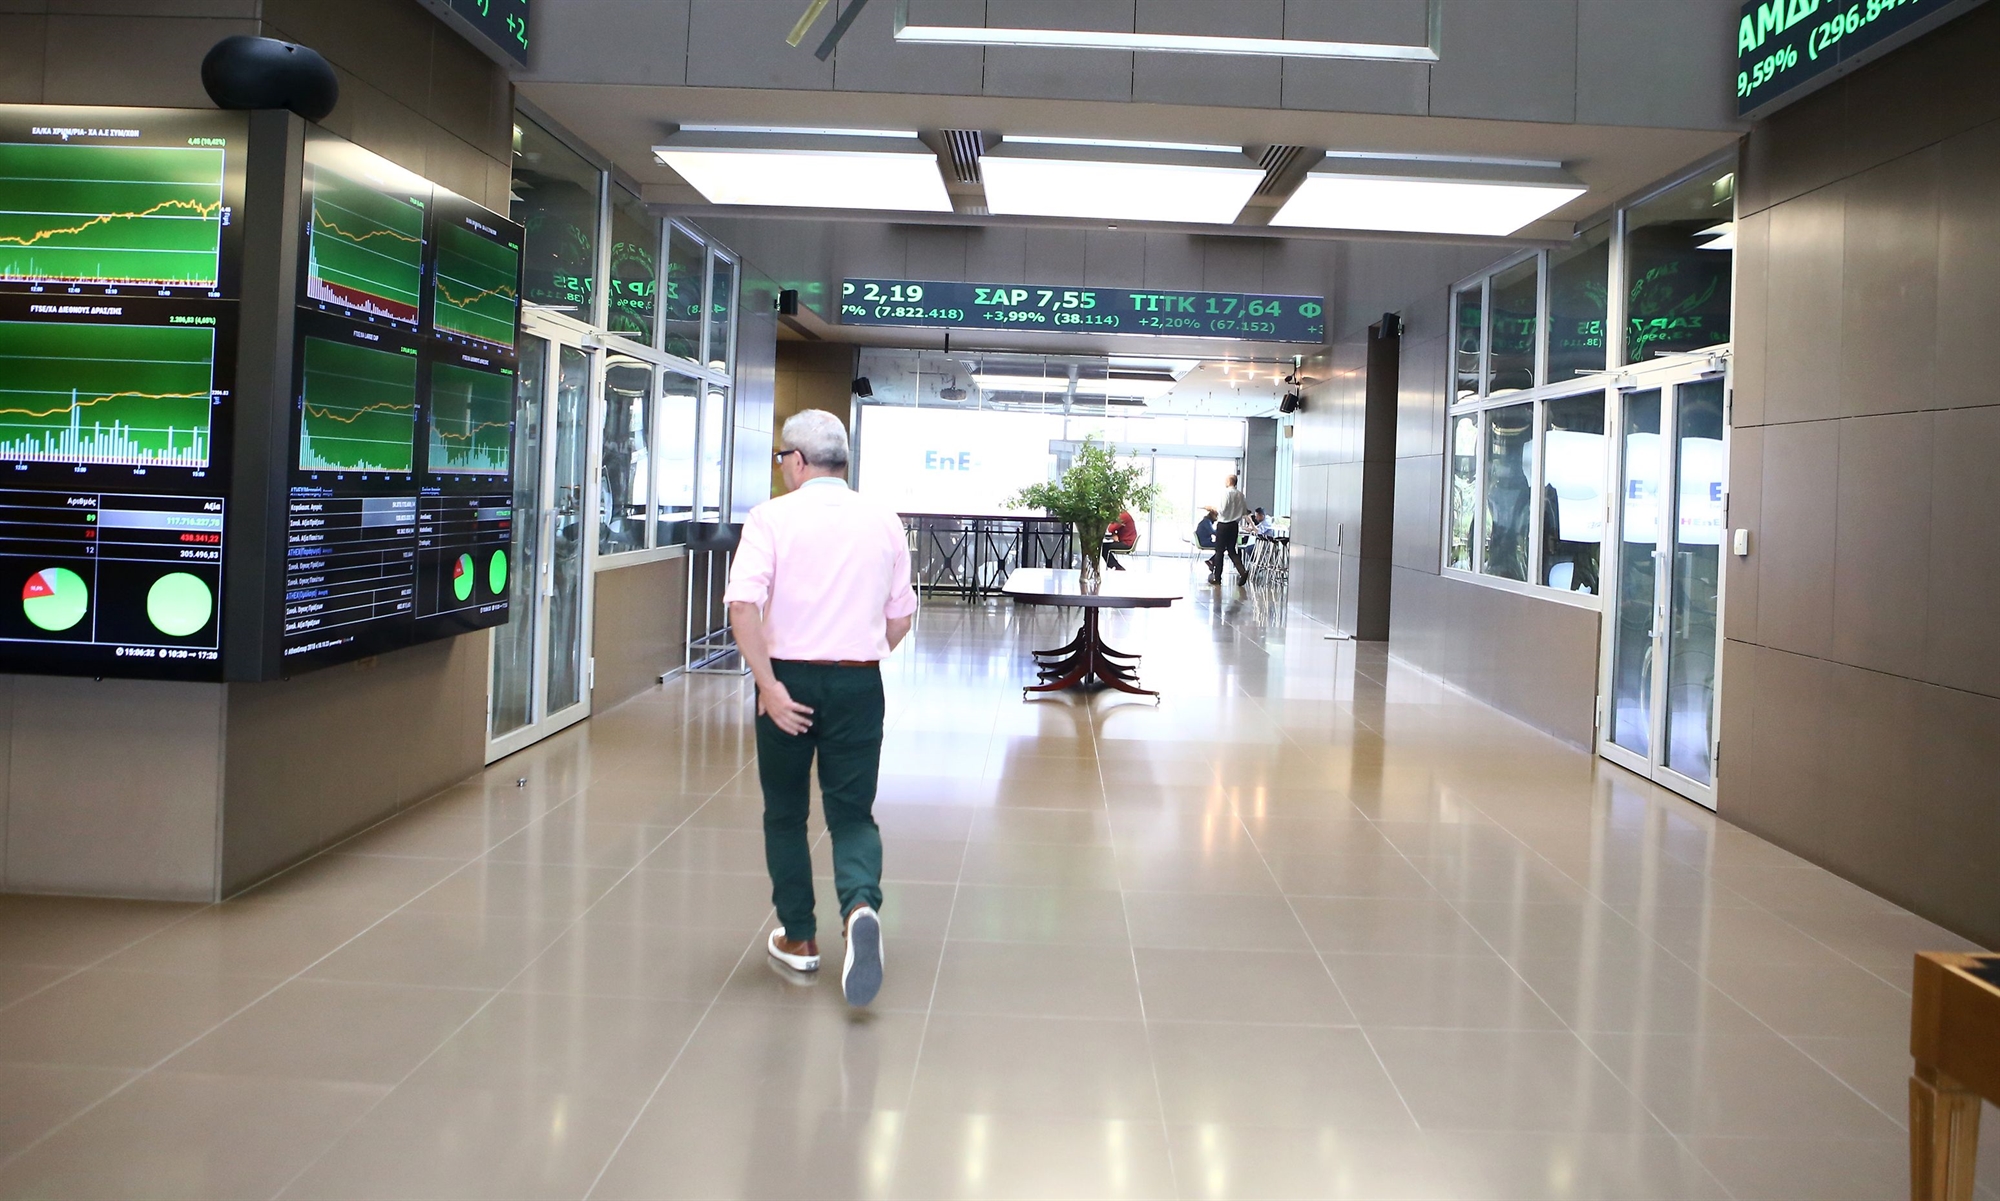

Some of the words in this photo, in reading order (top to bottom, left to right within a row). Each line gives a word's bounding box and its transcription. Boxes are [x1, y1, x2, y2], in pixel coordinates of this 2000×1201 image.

[863, 281, 925, 305] 2,19
[974, 288, 1029, 306] ΣΑΡ
[1036, 290, 1096, 312] 7,55
[1129, 293, 1197, 313] ΤΙΤΚ
[1205, 298, 1282, 319] 17,64
[874, 305, 965, 322] (7.822.418)
[983, 310, 1046, 324] +3,99%
[1054, 312, 1120, 328] (38.114)
[1138, 316, 1201, 330] +2,20%
[1210, 318, 1276, 335] (67.152)
[85, 546, 94, 554] 12
